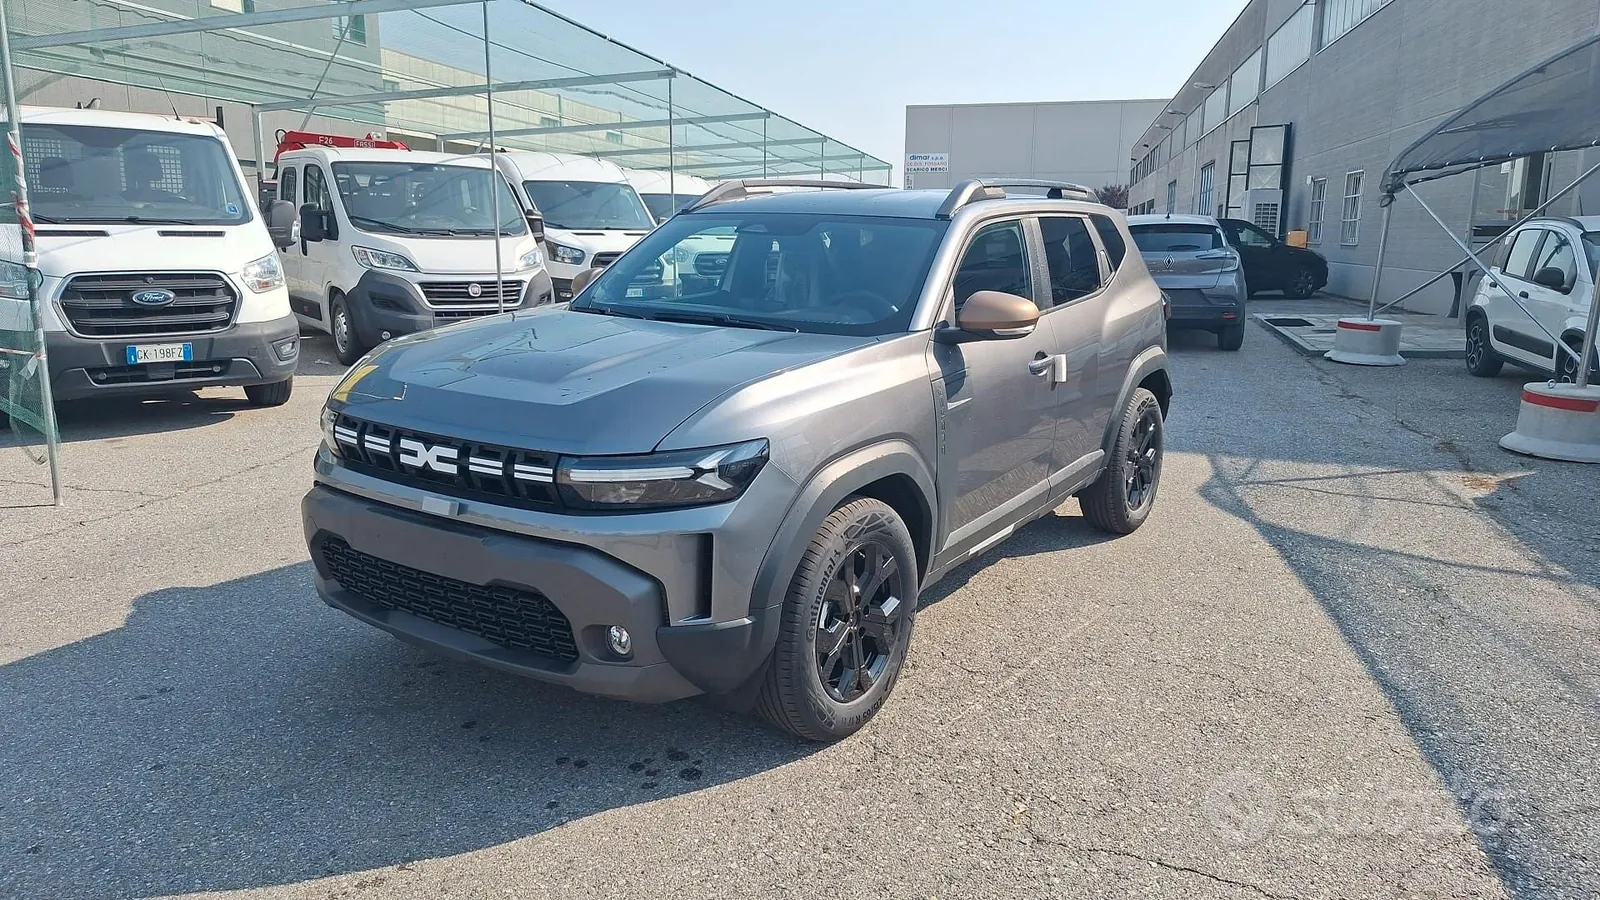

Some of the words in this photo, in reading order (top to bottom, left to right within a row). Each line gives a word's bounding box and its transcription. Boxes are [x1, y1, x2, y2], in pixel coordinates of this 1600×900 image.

[319, 136, 333, 144] F26
[142, 292, 165, 301] Ford
[806, 557, 837, 641] Continental
